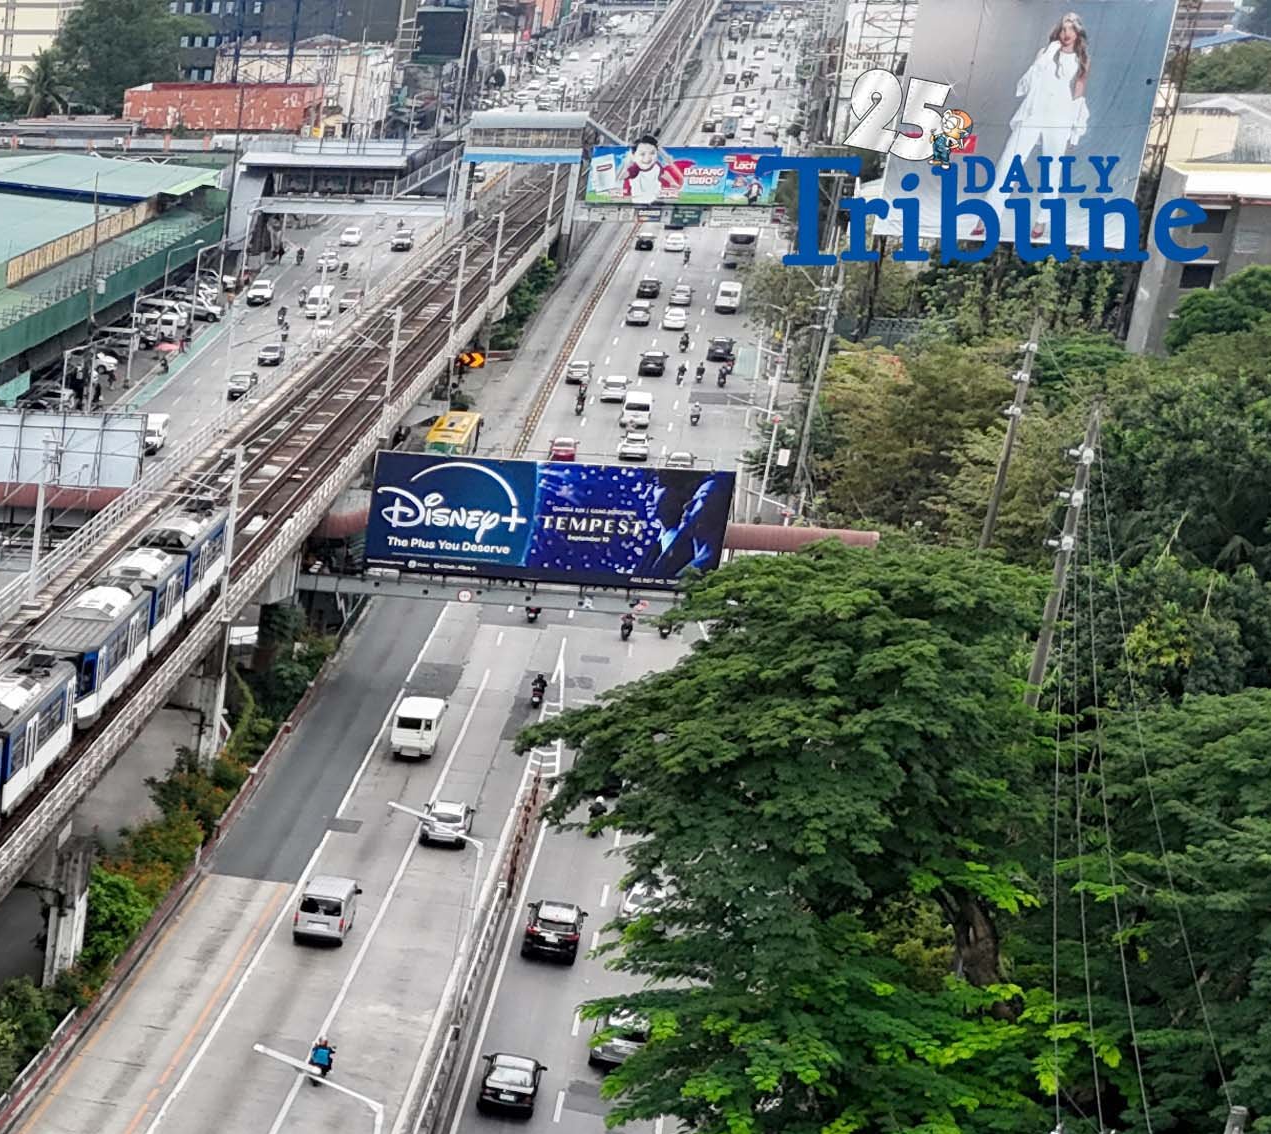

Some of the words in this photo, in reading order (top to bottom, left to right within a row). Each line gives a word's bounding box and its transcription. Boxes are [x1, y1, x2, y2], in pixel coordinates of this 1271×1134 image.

[683, 167, 724, 176] BATANG
[542, 515, 642, 537] TEMPEST
[387, 535, 408, 548] The
[410, 537, 435, 550] Plus
[438, 538, 460, 552] You
[462, 541, 511, 555] Deserve
